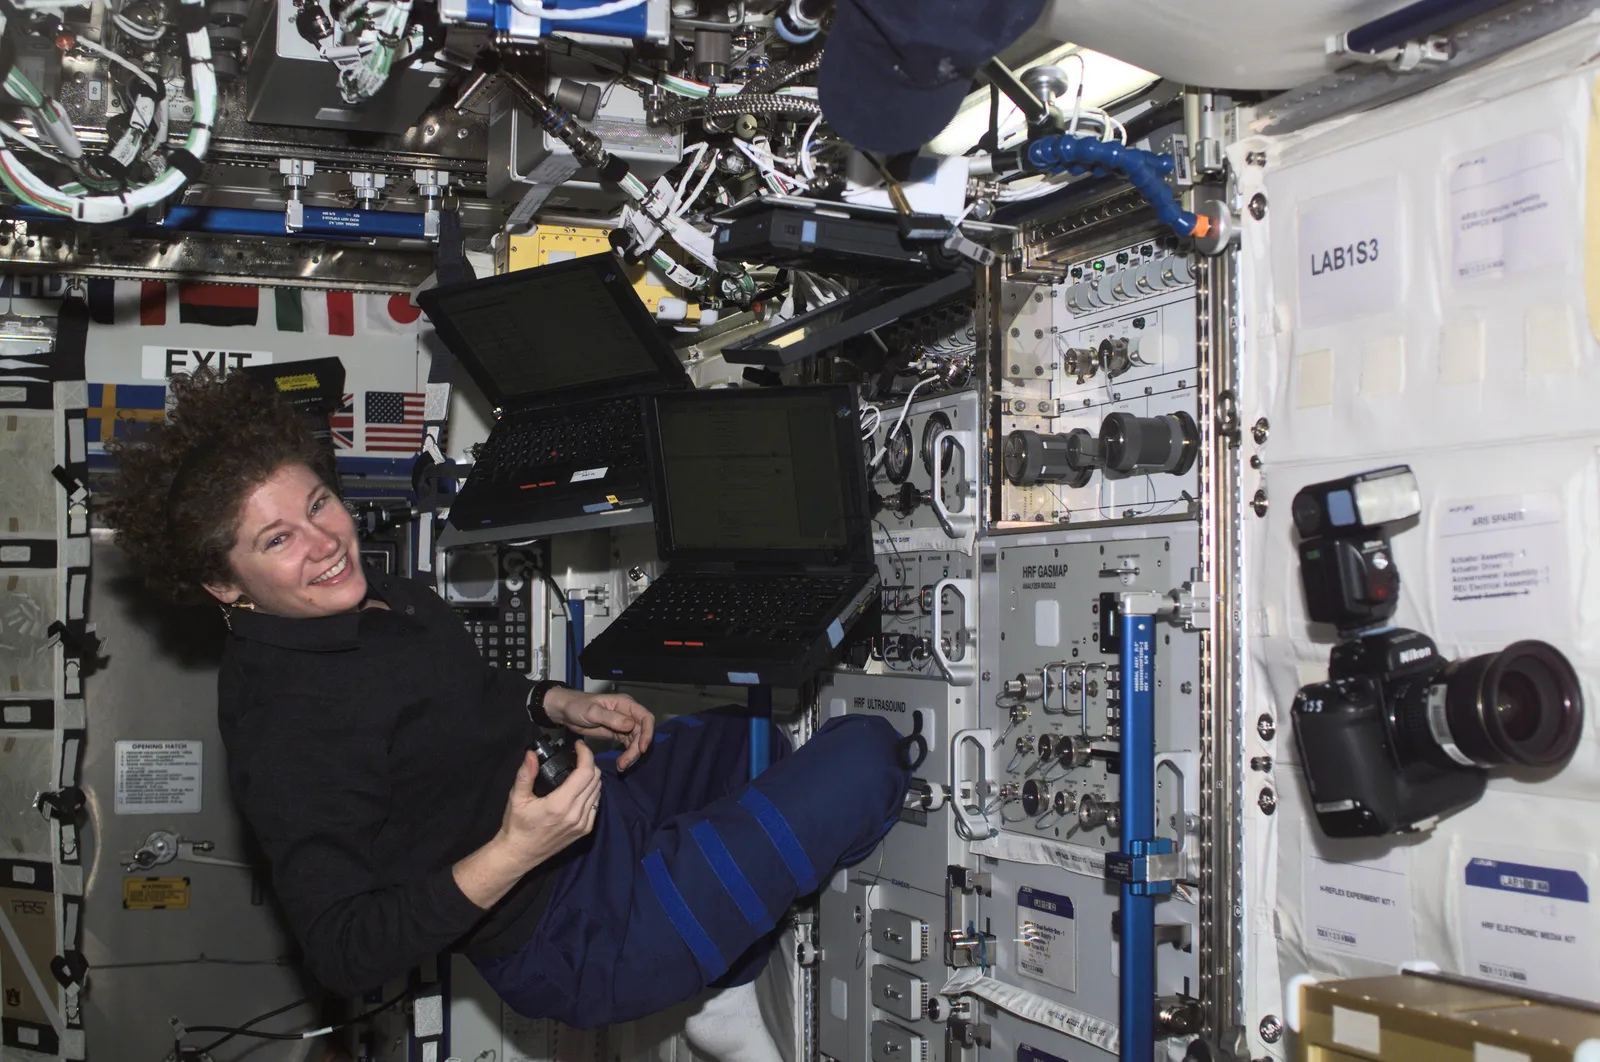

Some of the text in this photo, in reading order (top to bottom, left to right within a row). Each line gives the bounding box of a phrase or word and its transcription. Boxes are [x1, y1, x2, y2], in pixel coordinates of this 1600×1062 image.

[1311, 238, 1378, 276] LAB1S3
[166, 349, 252, 380] EXIT
[1022, 564, 1068, 578] HRF GASMAP
[1399, 646, 1431, 664] Nikon
[854, 697, 906, 713] HRF ULTRASOUND
[1320, 885, 1345, 896] H-REFLEX
[1346, 890, 1380, 904] EXPERIMENT
[1382, 898, 1391, 906] KIT
[1482, 921, 1576, 944] HRF ELECTRONIC MEDIA KIT
